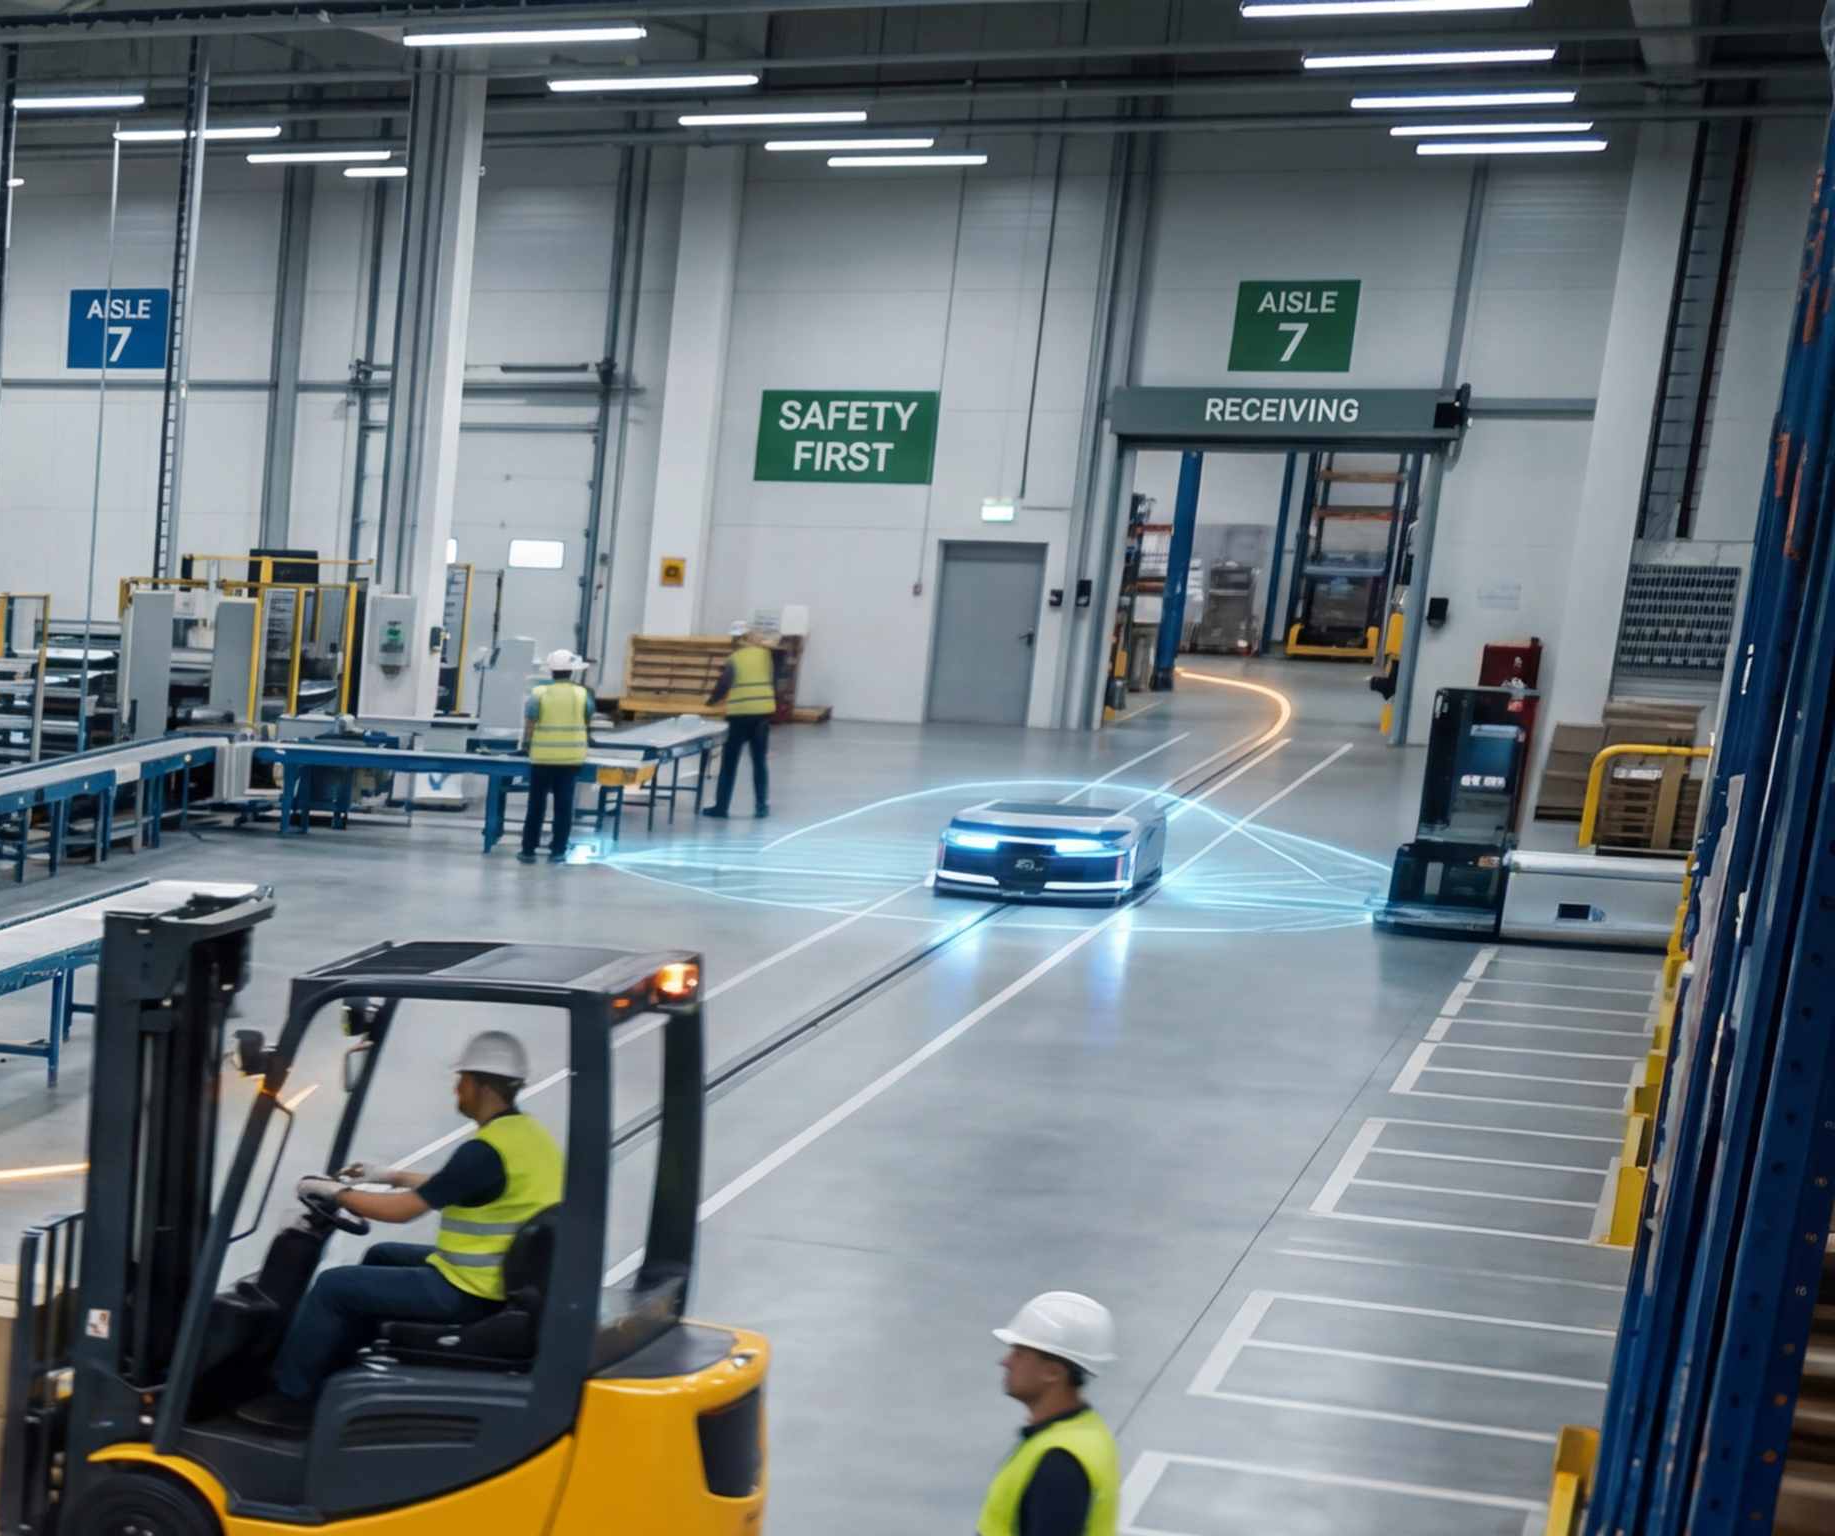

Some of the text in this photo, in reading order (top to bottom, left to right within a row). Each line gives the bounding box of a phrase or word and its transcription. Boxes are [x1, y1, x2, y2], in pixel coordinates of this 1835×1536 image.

[1257, 291, 1338, 313] AISLE
[107, 326, 132, 362] 7
[1278, 323, 1309, 362] 7
[778, 400, 918, 431] SAFETY
[1204, 398, 1359, 422] RECEIVING
[793, 441, 894, 472] FIRST
